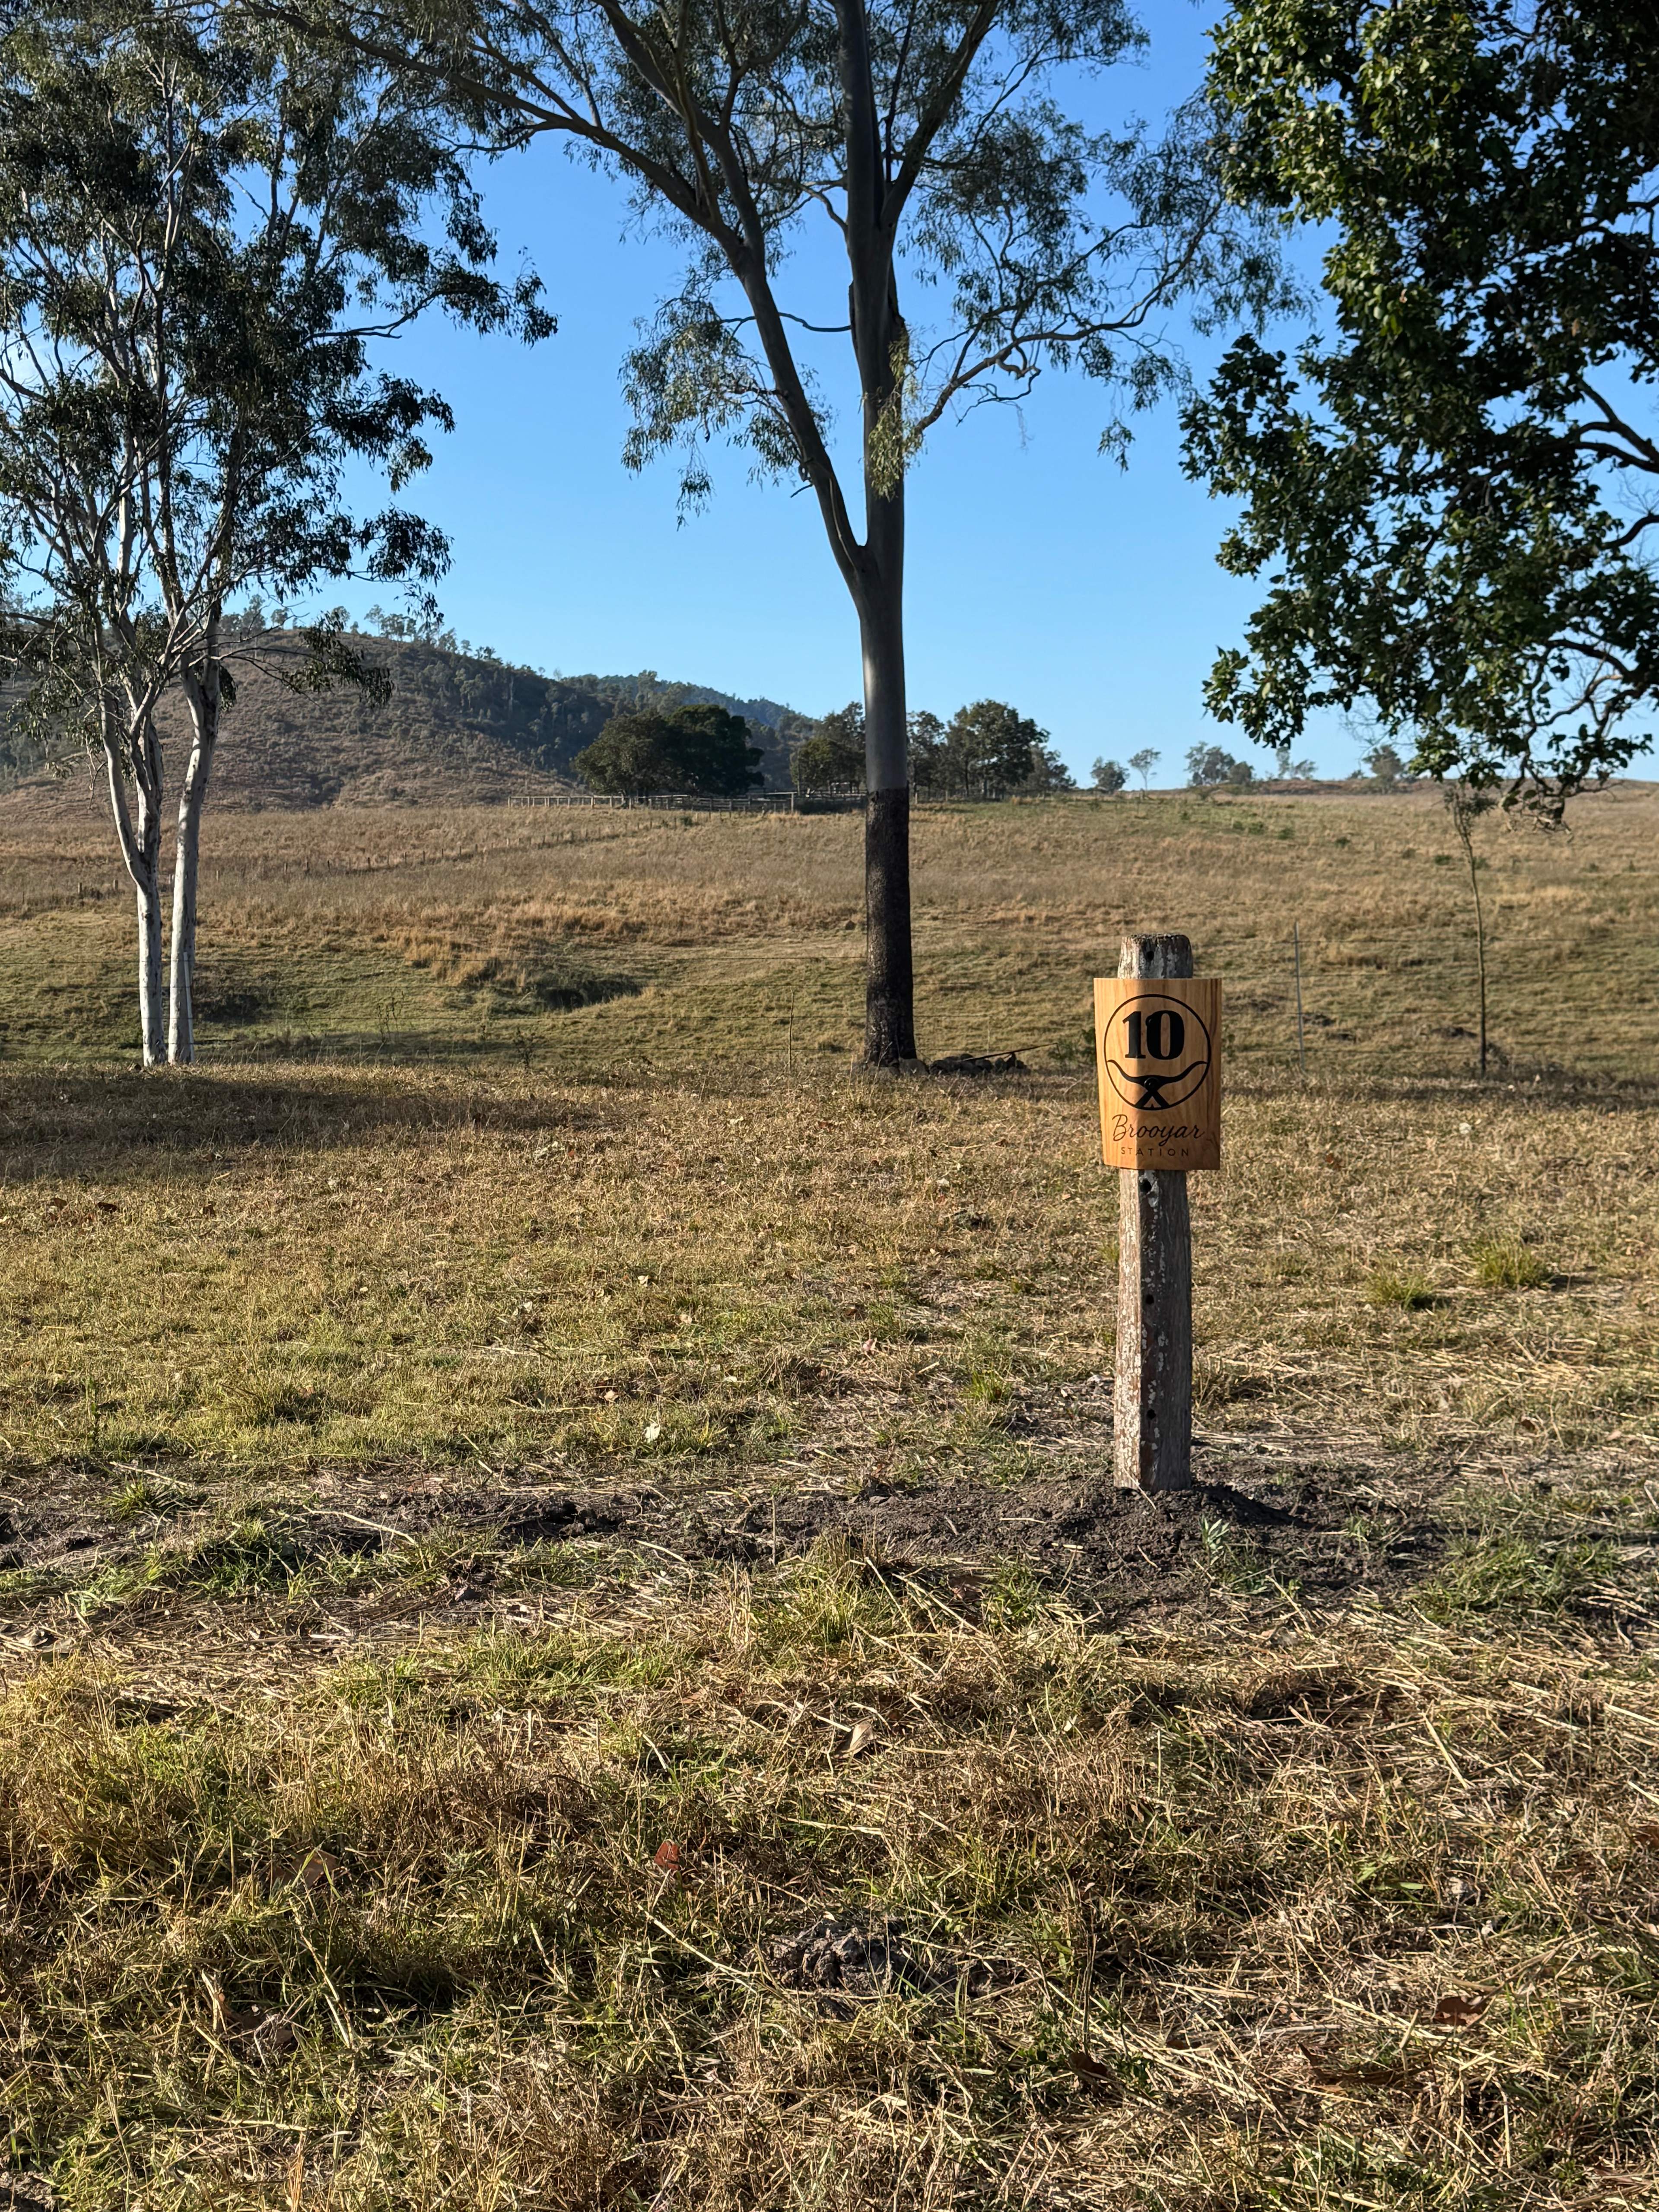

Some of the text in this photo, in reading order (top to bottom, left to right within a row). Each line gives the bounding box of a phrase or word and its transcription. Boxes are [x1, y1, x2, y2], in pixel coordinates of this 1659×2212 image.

[1122, 1010, 1185, 1060] 10
[1112, 1114, 1205, 1146] Brooyar
[1121, 1147, 1188, 1156] STATION
